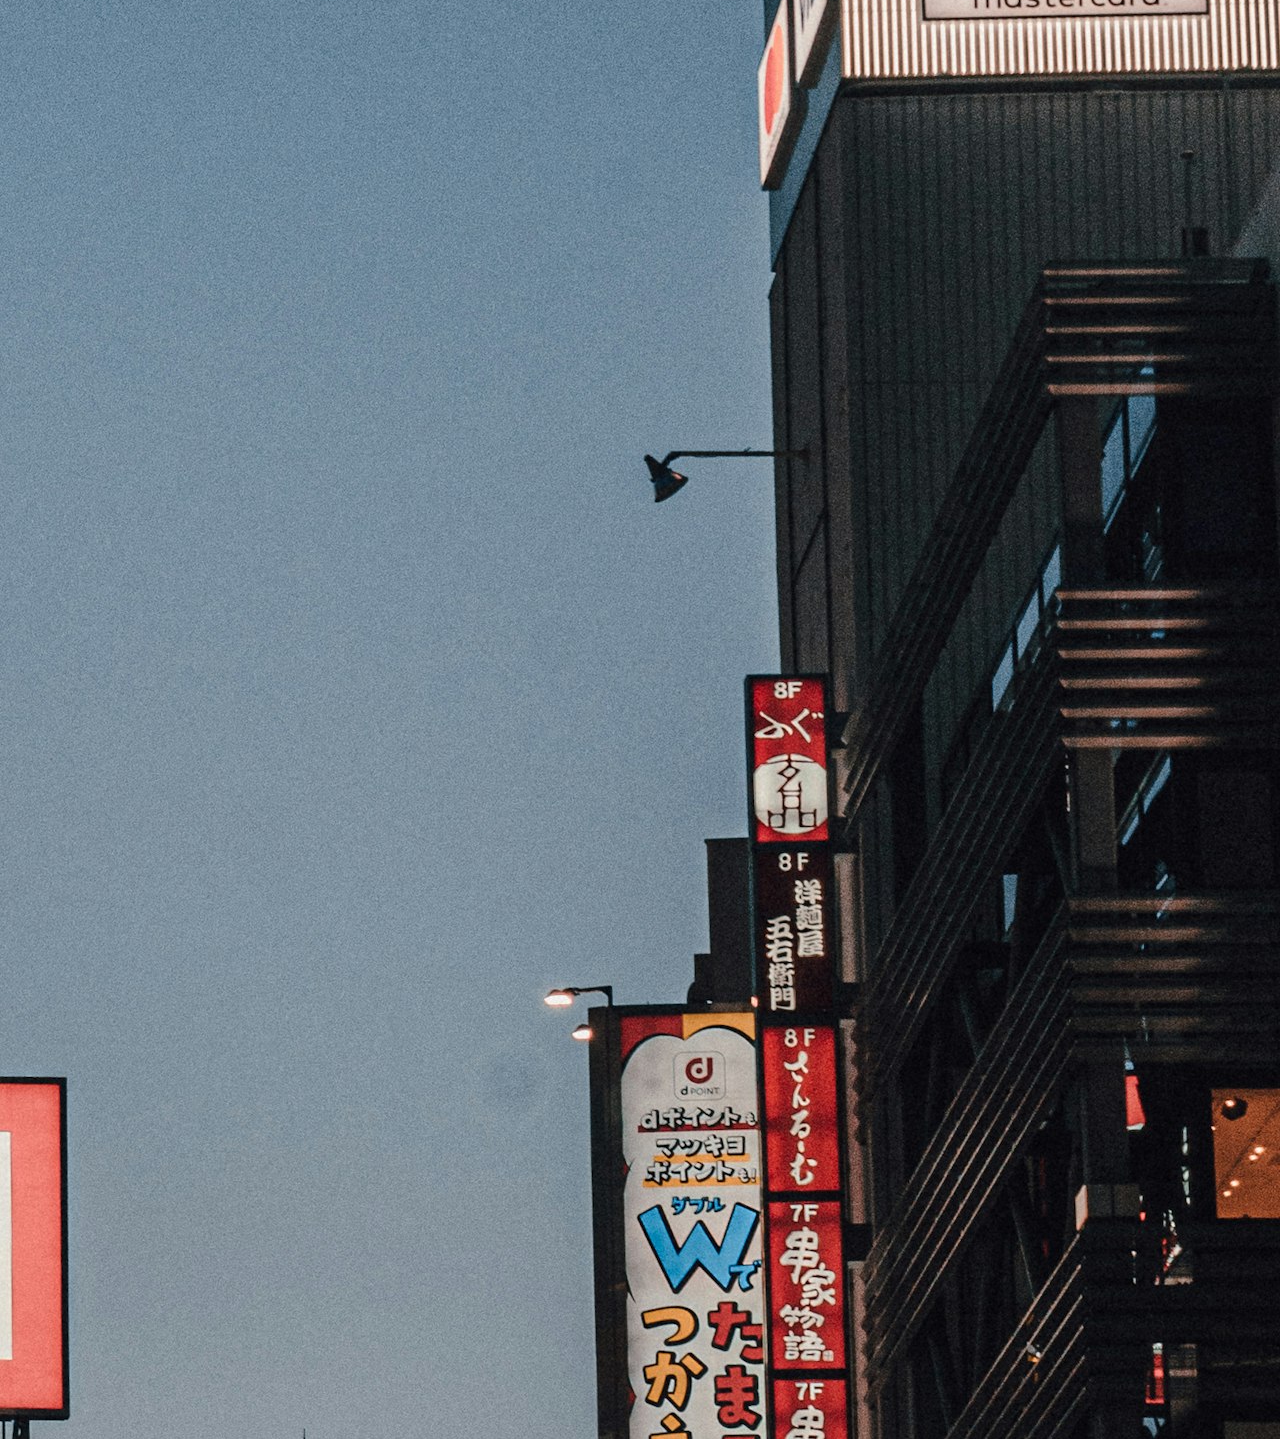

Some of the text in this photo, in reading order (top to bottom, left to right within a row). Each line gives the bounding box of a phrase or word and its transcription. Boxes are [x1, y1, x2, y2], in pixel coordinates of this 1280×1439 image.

[773, 681, 803, 699] 8F
[754, 708, 825, 744] ふぐ
[778, 852, 809, 872] 8F
[766, 915, 798, 1012] 五右衛門
[783, 1028, 817, 1048] 8F
[690, 1087, 720, 1096] POINT
[783, 1050, 819, 1187] さんるーむ
[655, 1134, 747, 1158] マツキヨ
[671, 1196, 726, 1215] ダブル
[789, 1204, 819, 1223] 7F
[779, 1227, 837, 1362] 串家物語
[794, 1382, 825, 1401] 7F
